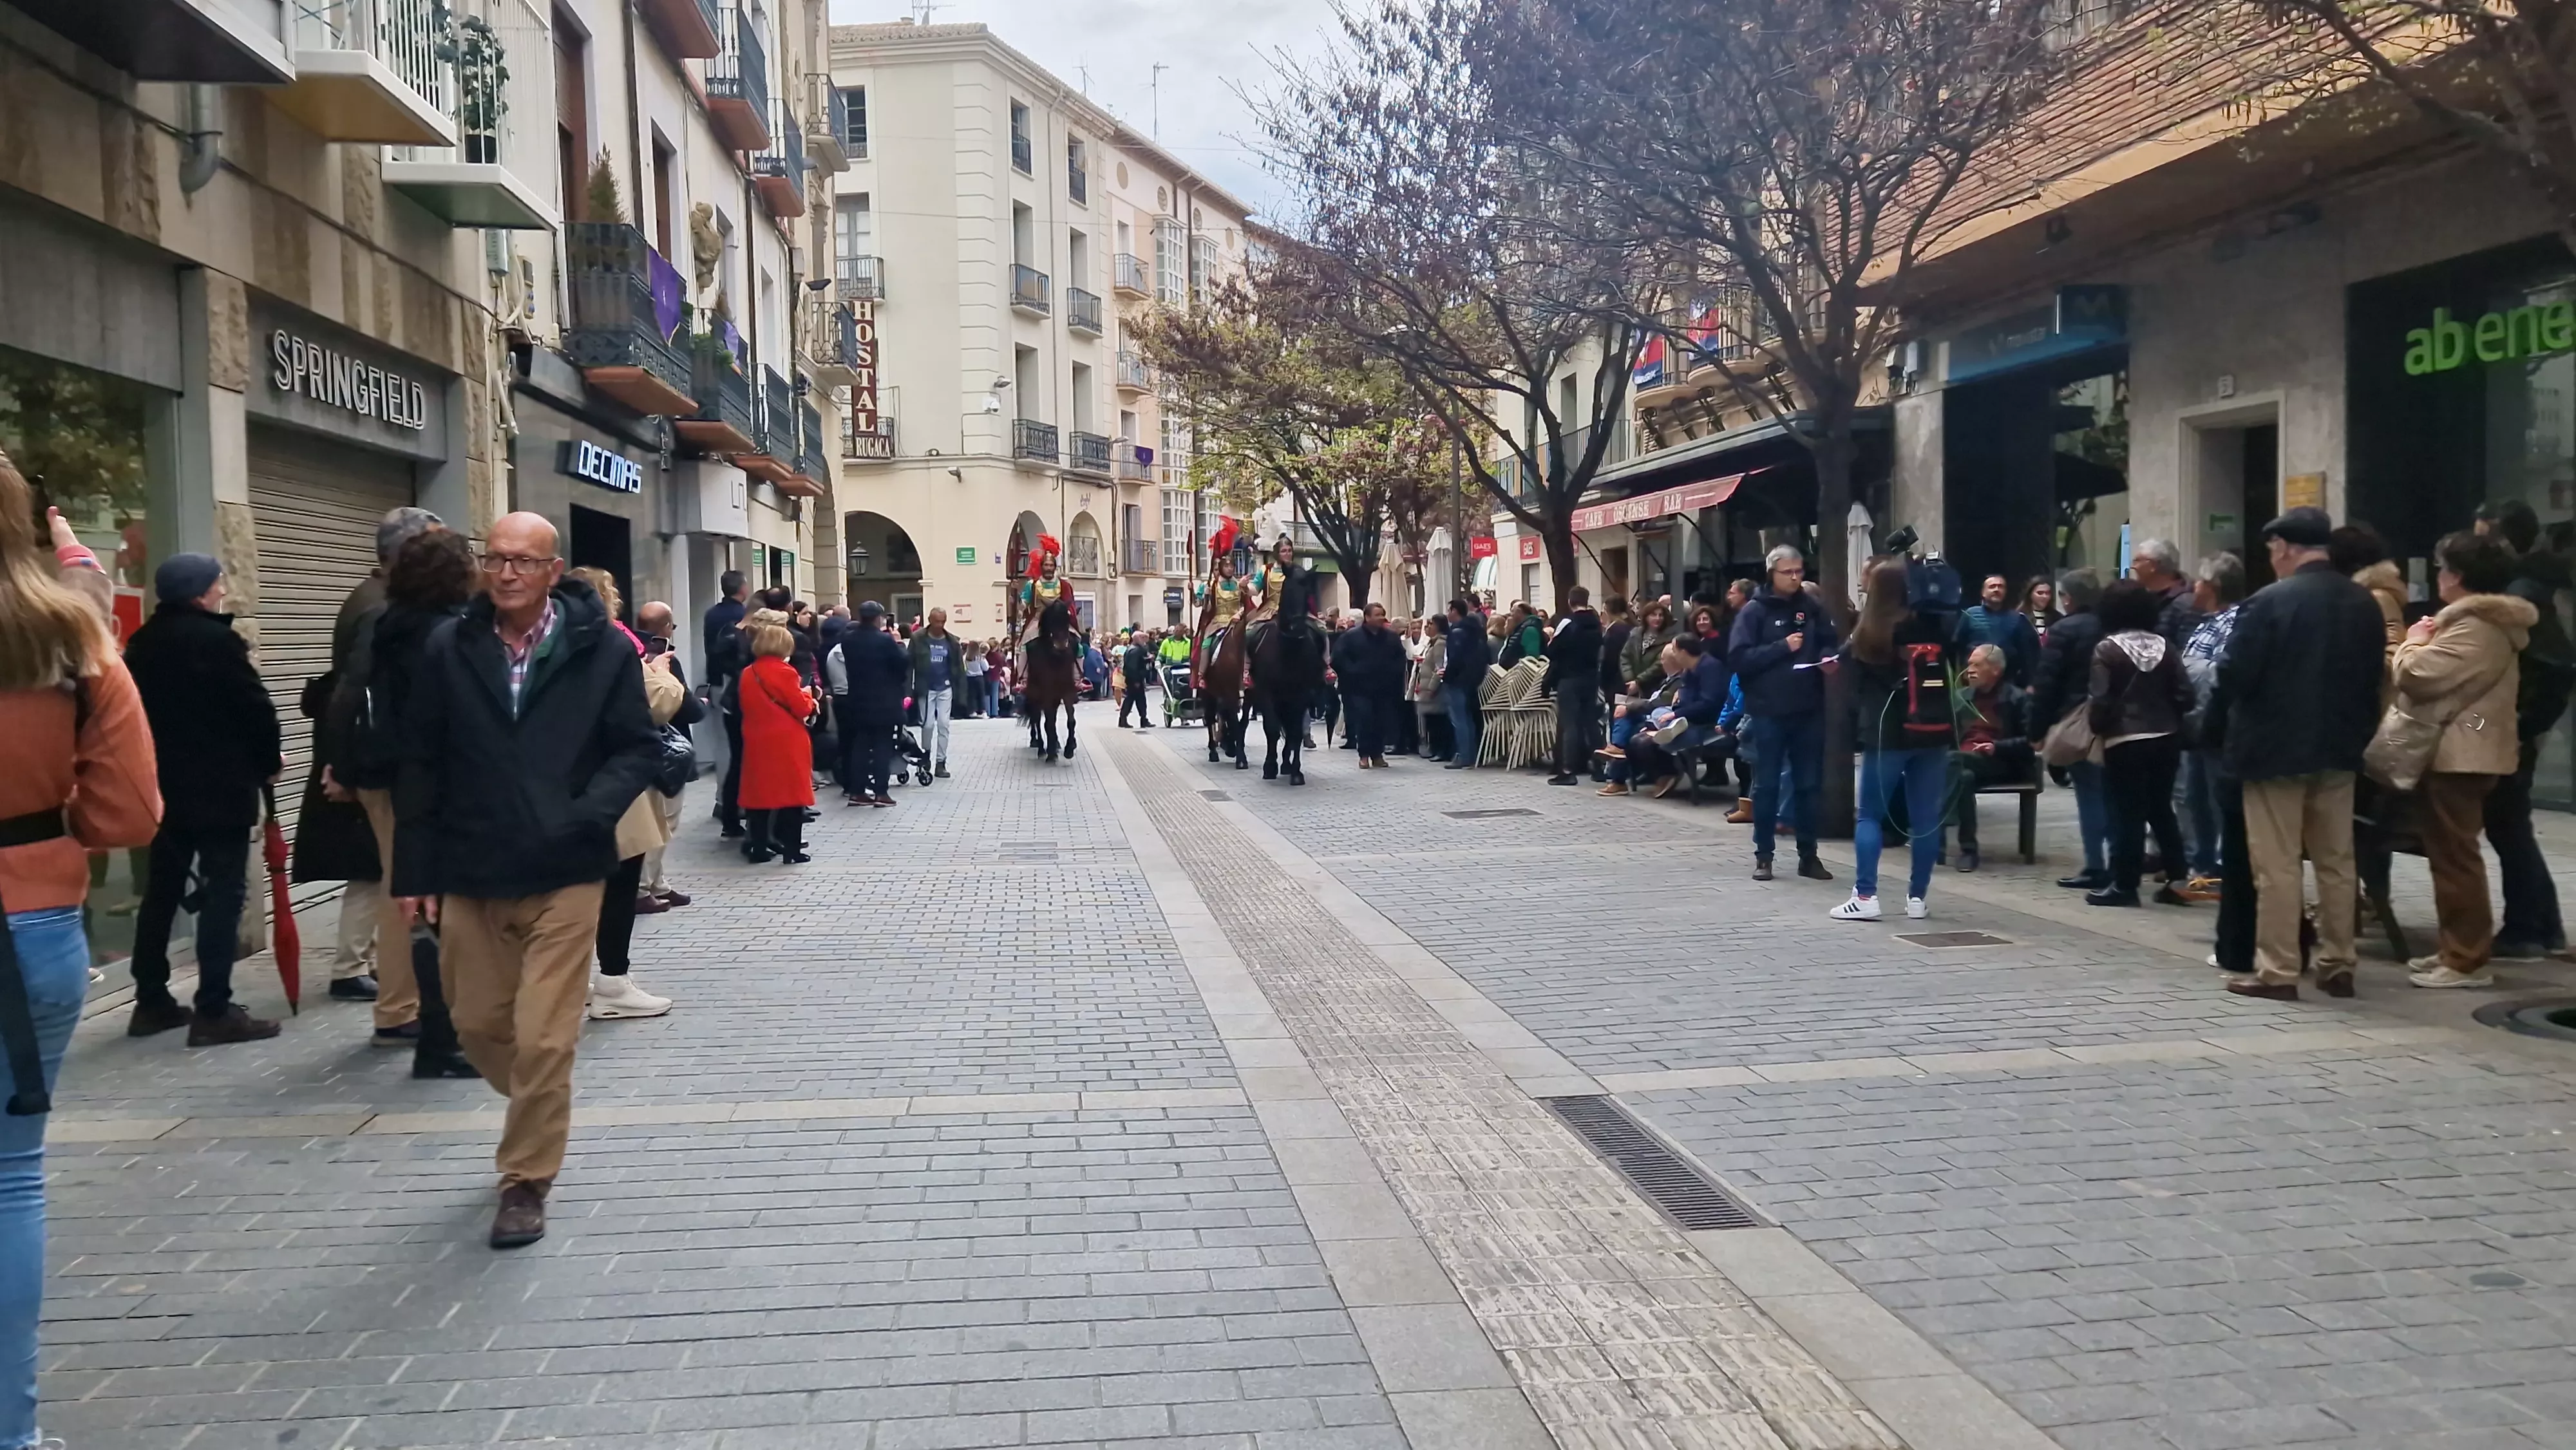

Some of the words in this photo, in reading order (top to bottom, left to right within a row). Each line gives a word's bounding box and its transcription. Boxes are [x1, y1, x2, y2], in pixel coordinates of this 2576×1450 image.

[274, 329, 426, 430] SPRINGFIELD
[853, 300, 876, 432] HOSTAL
[578, 439, 643, 494] DECIMAS
[855, 437, 891, 457] RUGACA
